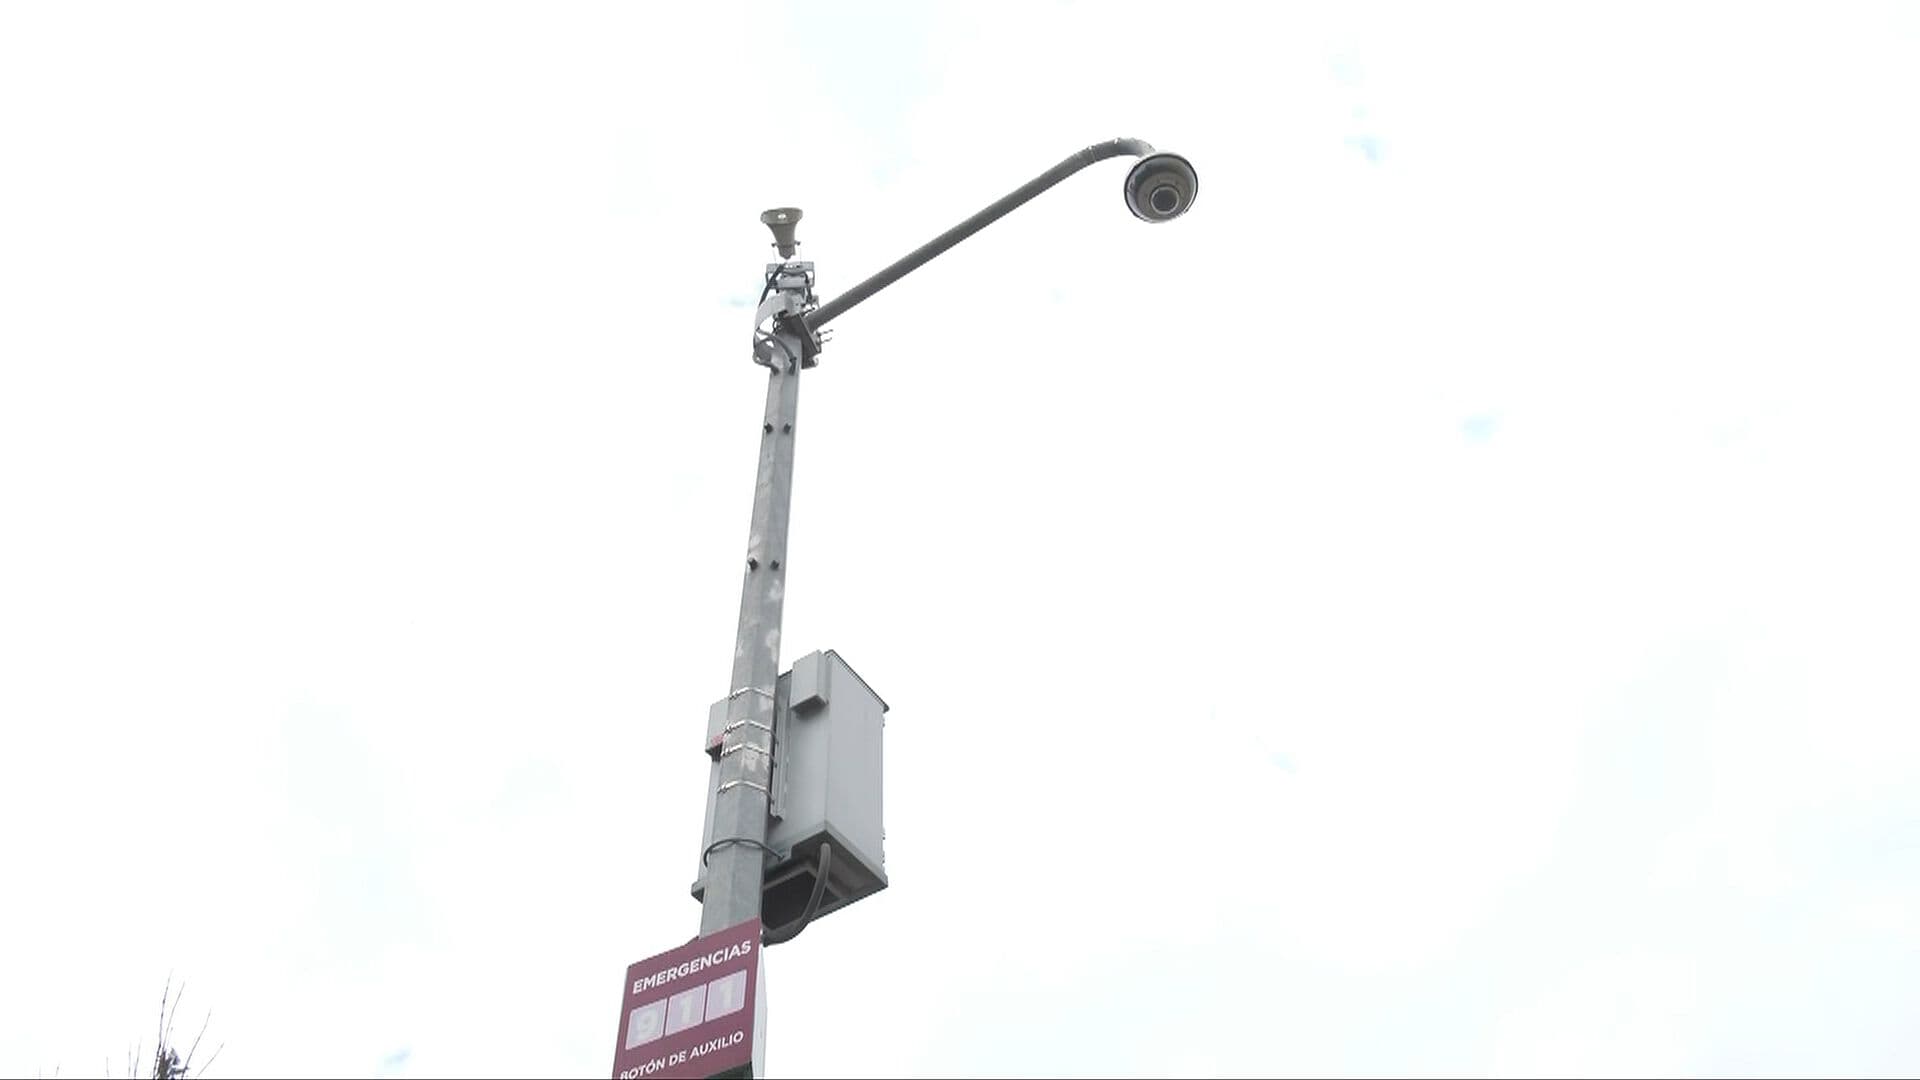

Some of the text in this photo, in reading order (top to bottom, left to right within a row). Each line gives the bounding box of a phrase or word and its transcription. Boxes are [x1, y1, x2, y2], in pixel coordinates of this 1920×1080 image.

[632, 940, 752, 994] EMERGENCIAS
[634, 979, 735, 1041] 911
[669, 1050, 686, 1066] DE
[690, 1031, 744, 1058] AUXILIO
